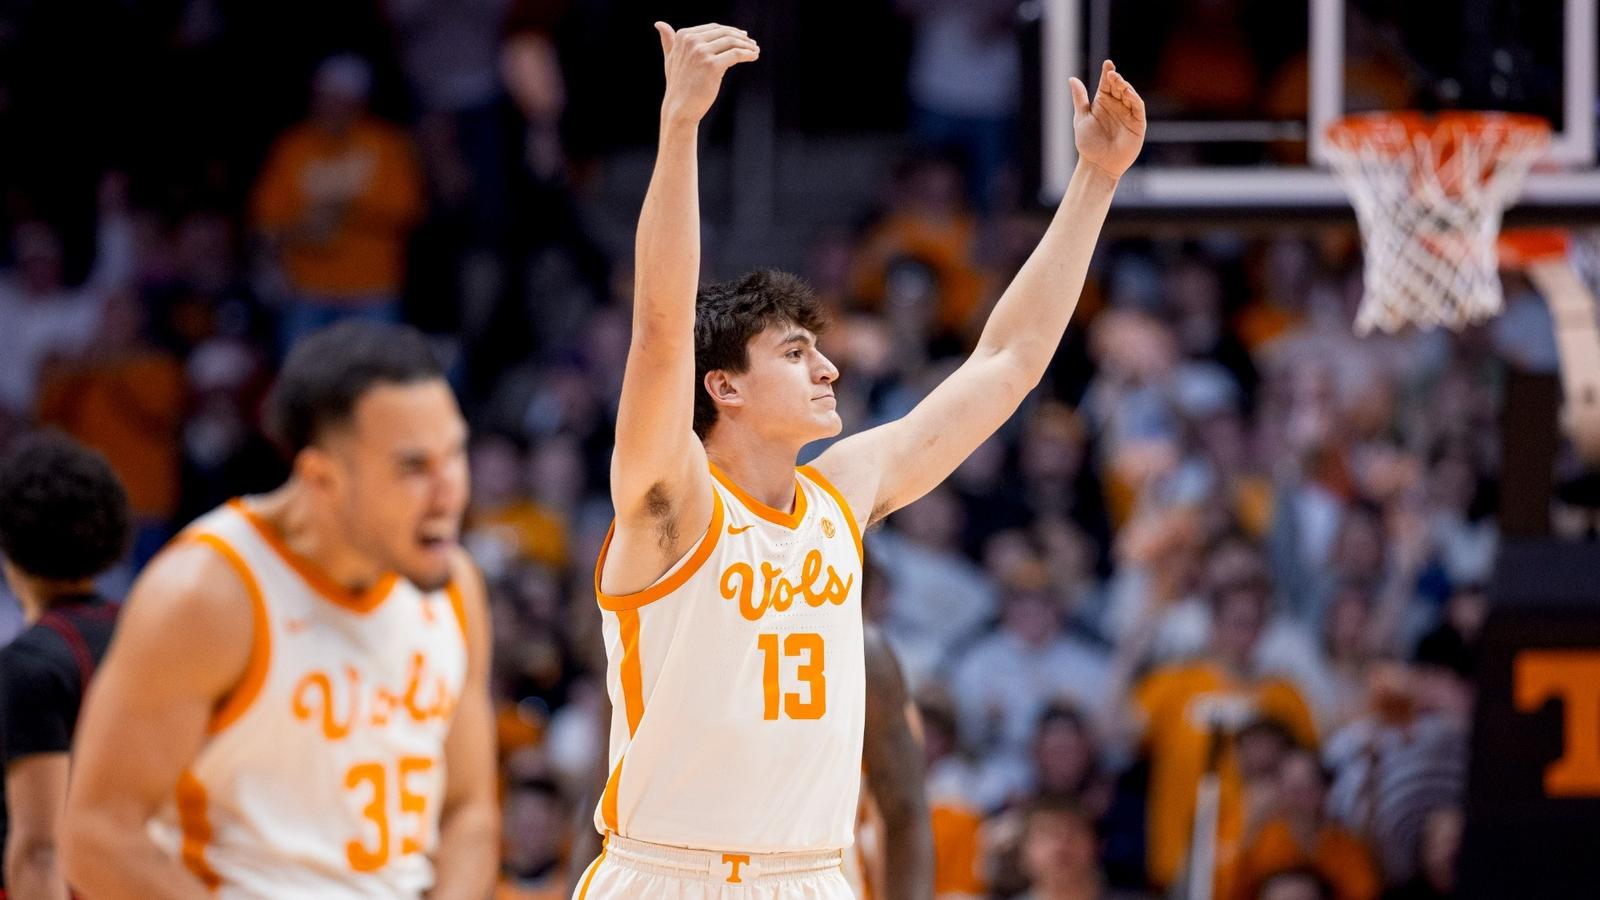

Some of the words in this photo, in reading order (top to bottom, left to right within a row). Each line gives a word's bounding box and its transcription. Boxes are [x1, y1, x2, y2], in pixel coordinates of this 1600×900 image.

[719, 549, 853, 621] Vols
[757, 632, 826, 721] 13
[1513, 650, 1600, 797] T
[344, 756, 434, 873] 35
[721, 853, 751, 884] T
